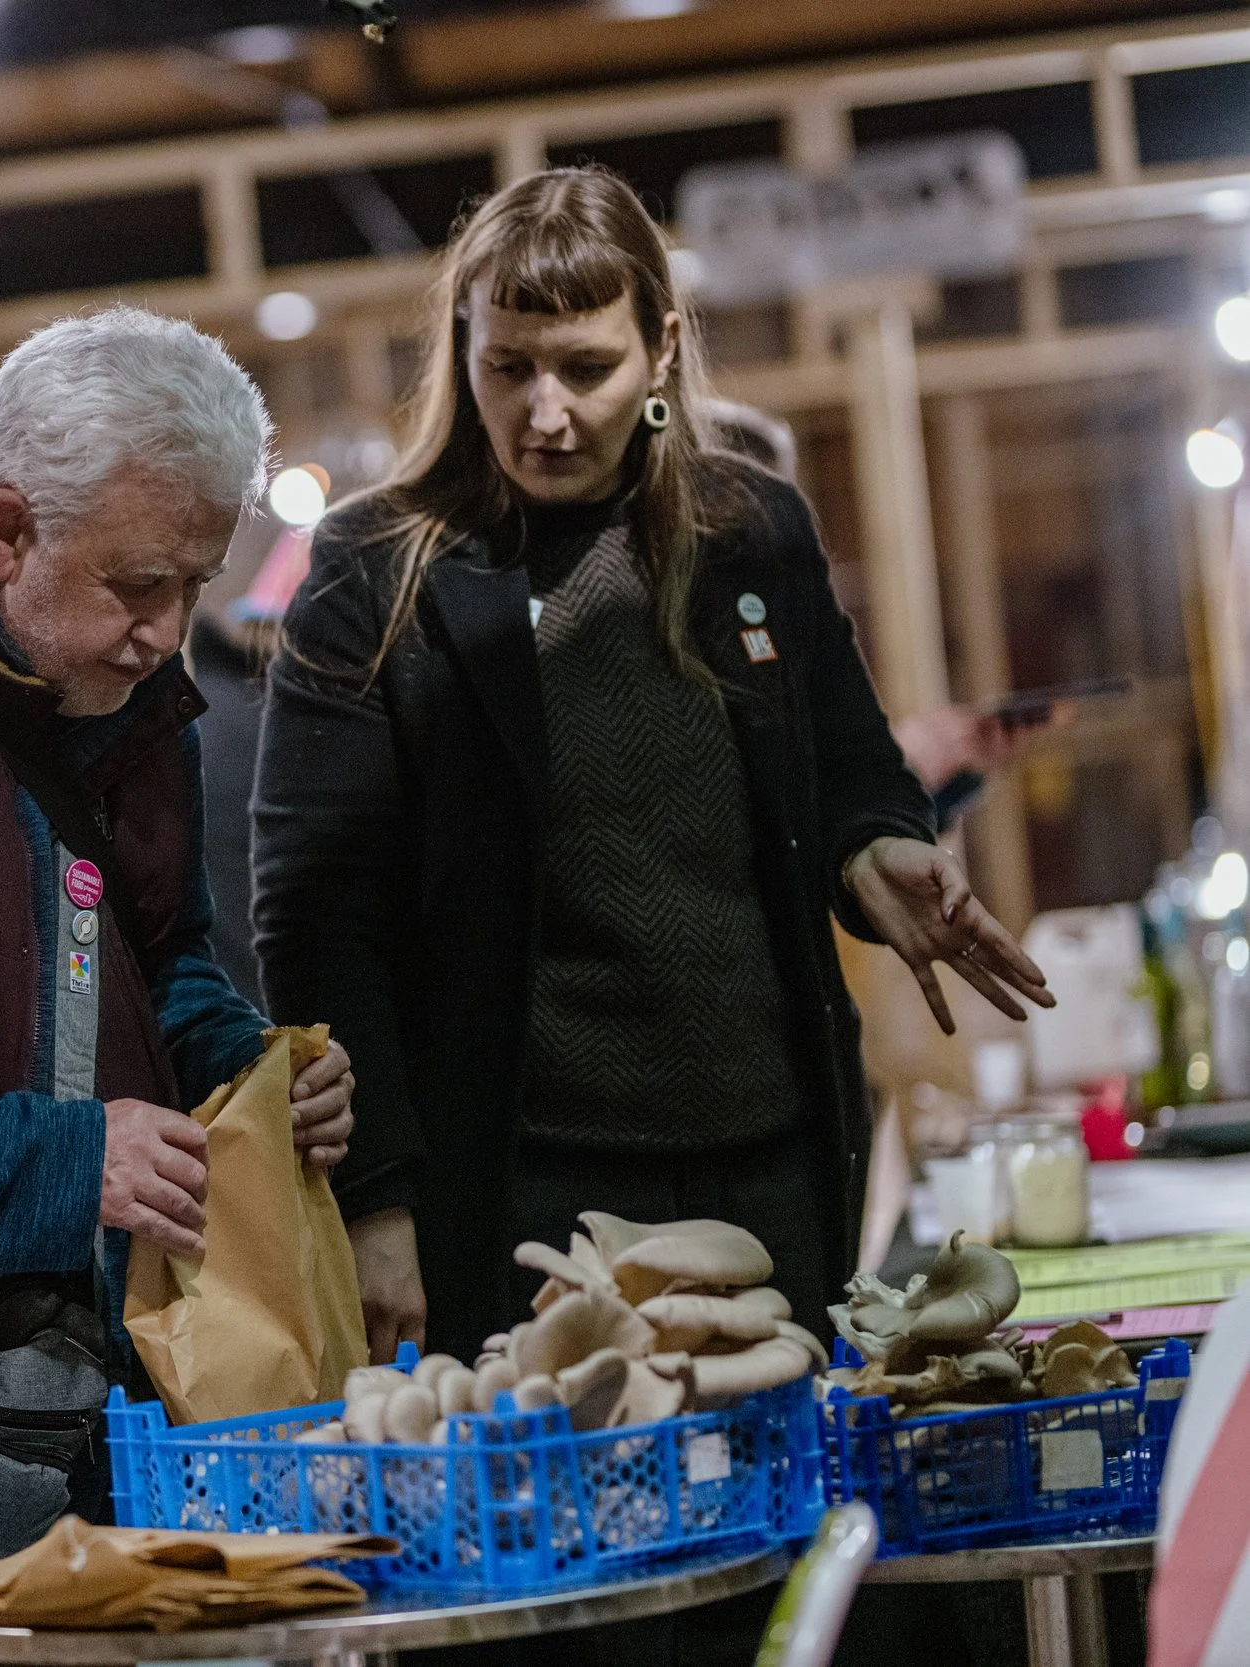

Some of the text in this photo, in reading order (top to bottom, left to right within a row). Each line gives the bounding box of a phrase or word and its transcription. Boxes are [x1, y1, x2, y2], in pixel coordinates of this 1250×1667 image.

[72, 868, 100, 887] SUSTAINABLE
[71, 878, 84, 890] FOOD
[71, 979, 89, 988] Thrive
